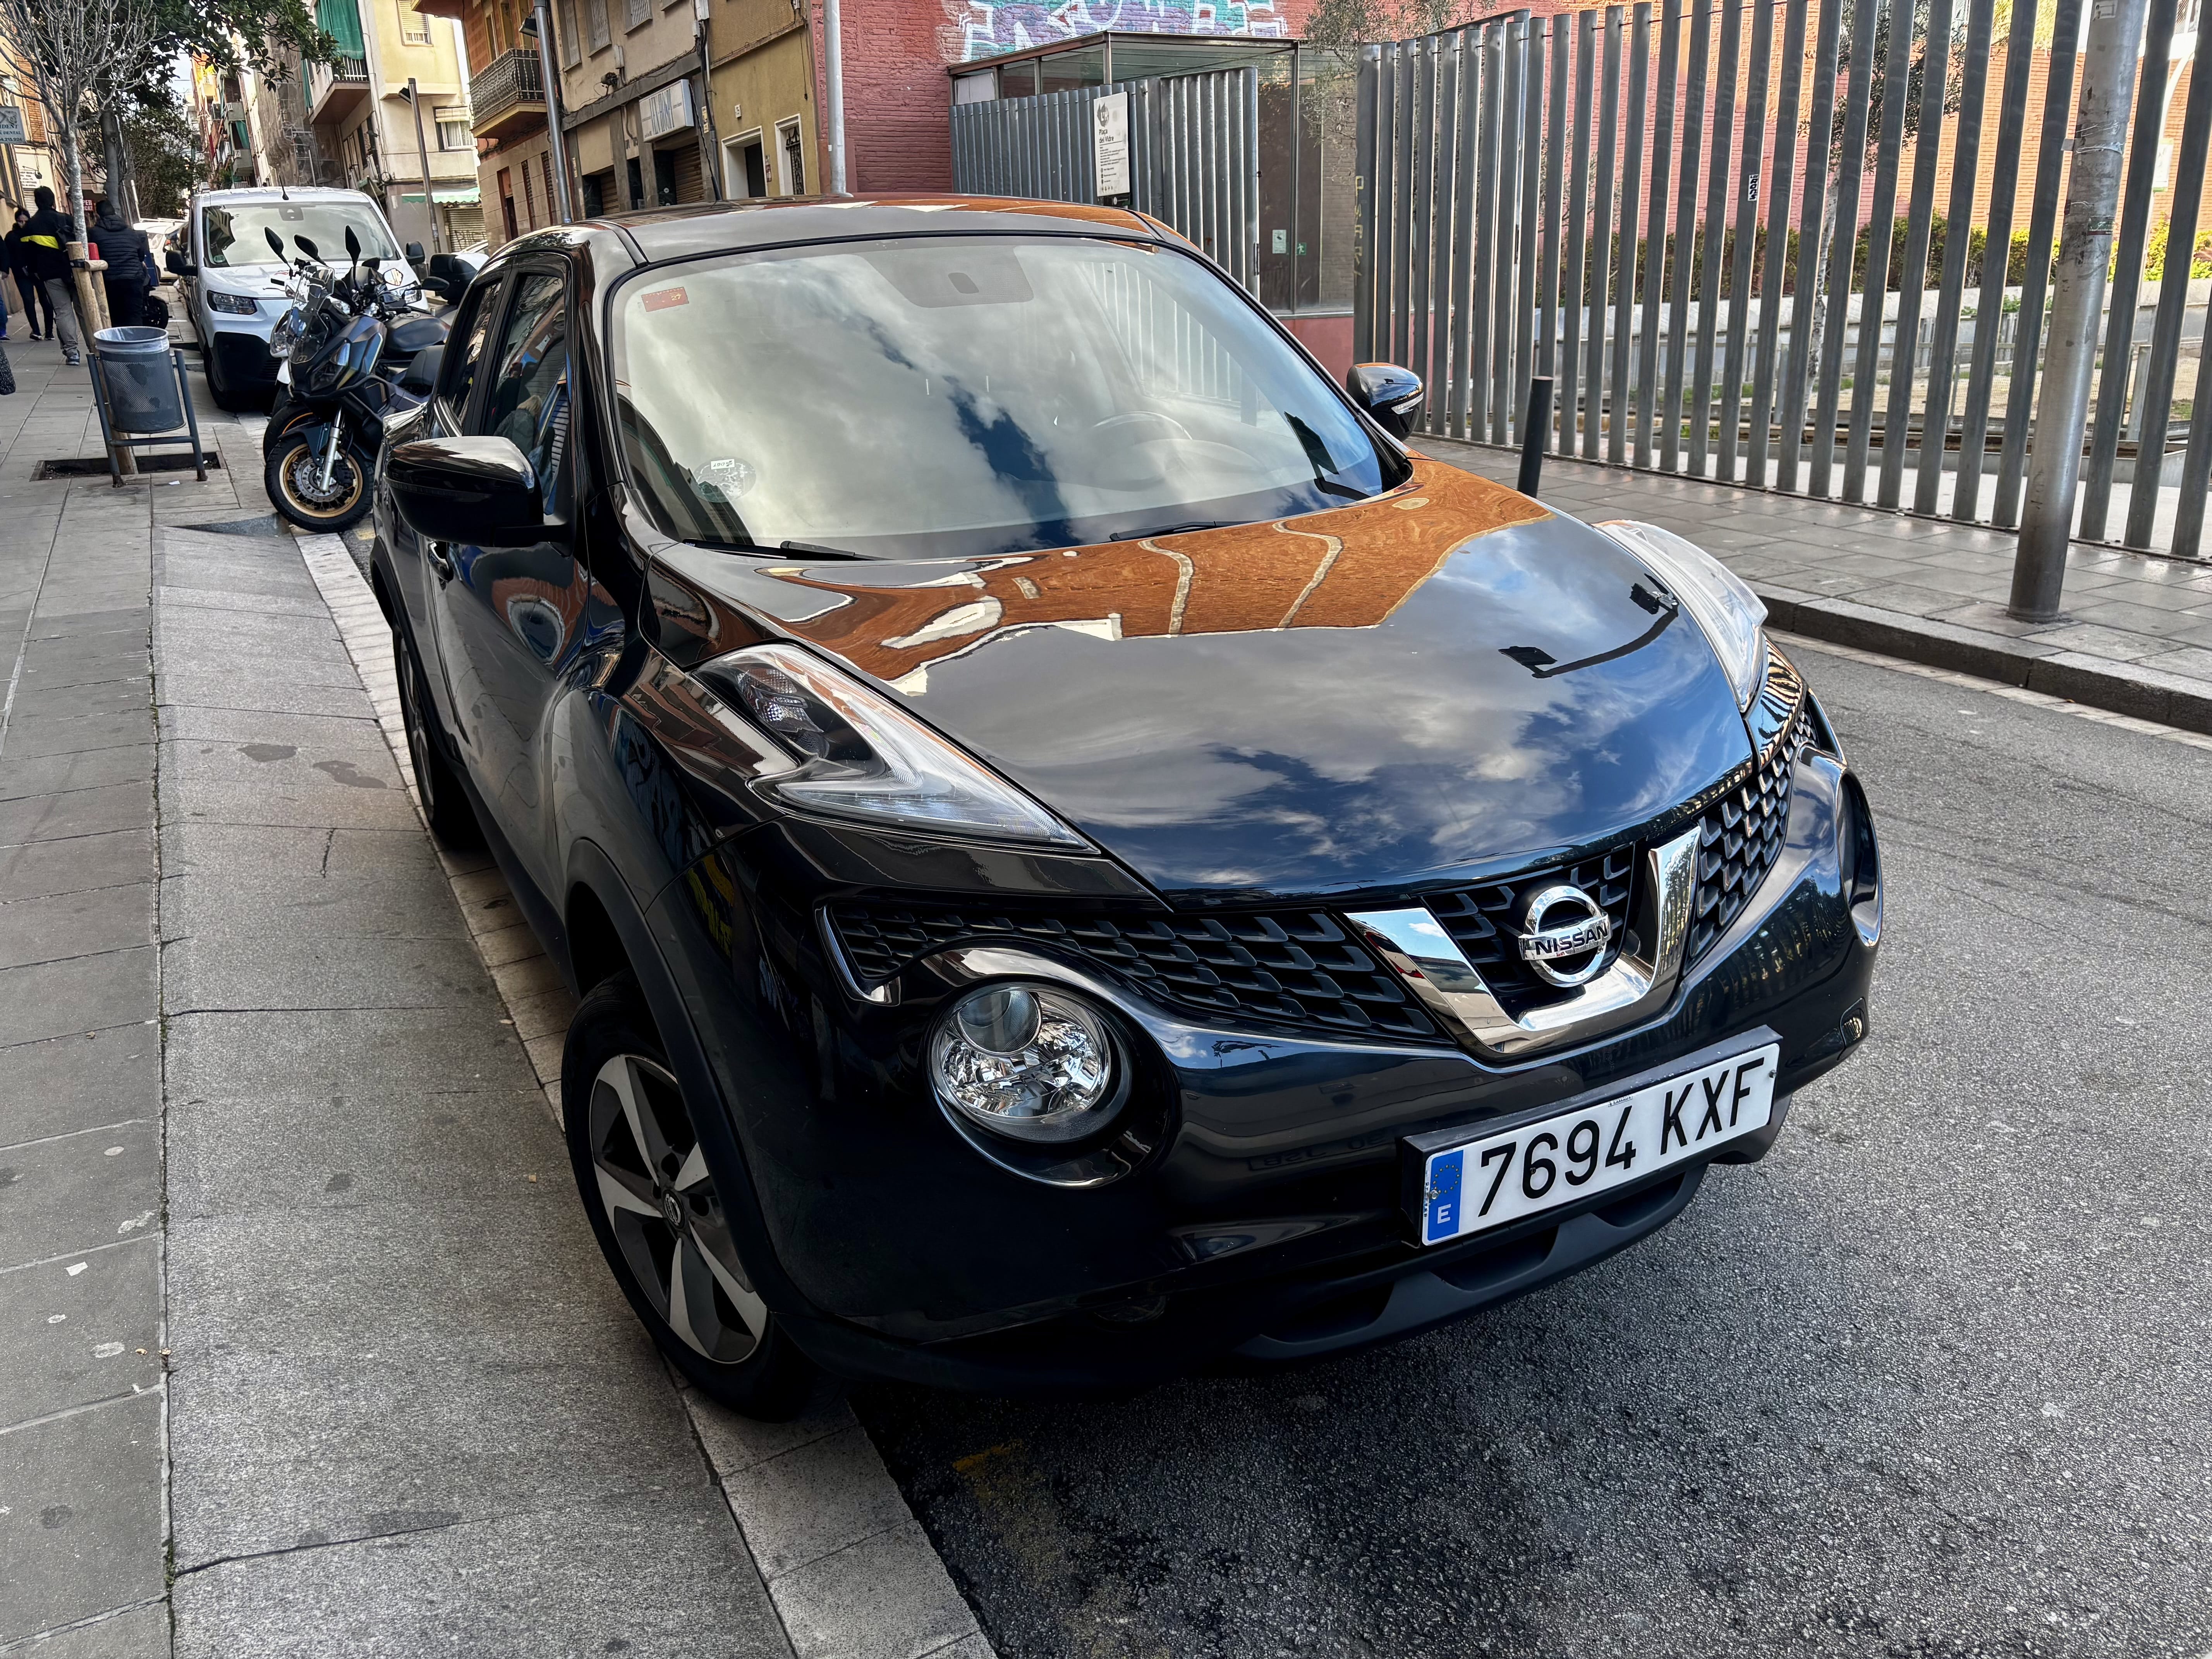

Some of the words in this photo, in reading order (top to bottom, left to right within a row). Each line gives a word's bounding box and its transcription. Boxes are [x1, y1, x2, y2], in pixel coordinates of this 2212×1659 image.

[1534, 920, 1607, 955] NISSAN
[1478, 1105, 1636, 1217] 7694
[1660, 1057, 1764, 1155] KXF
[1437, 1204, 1451, 1224] E
